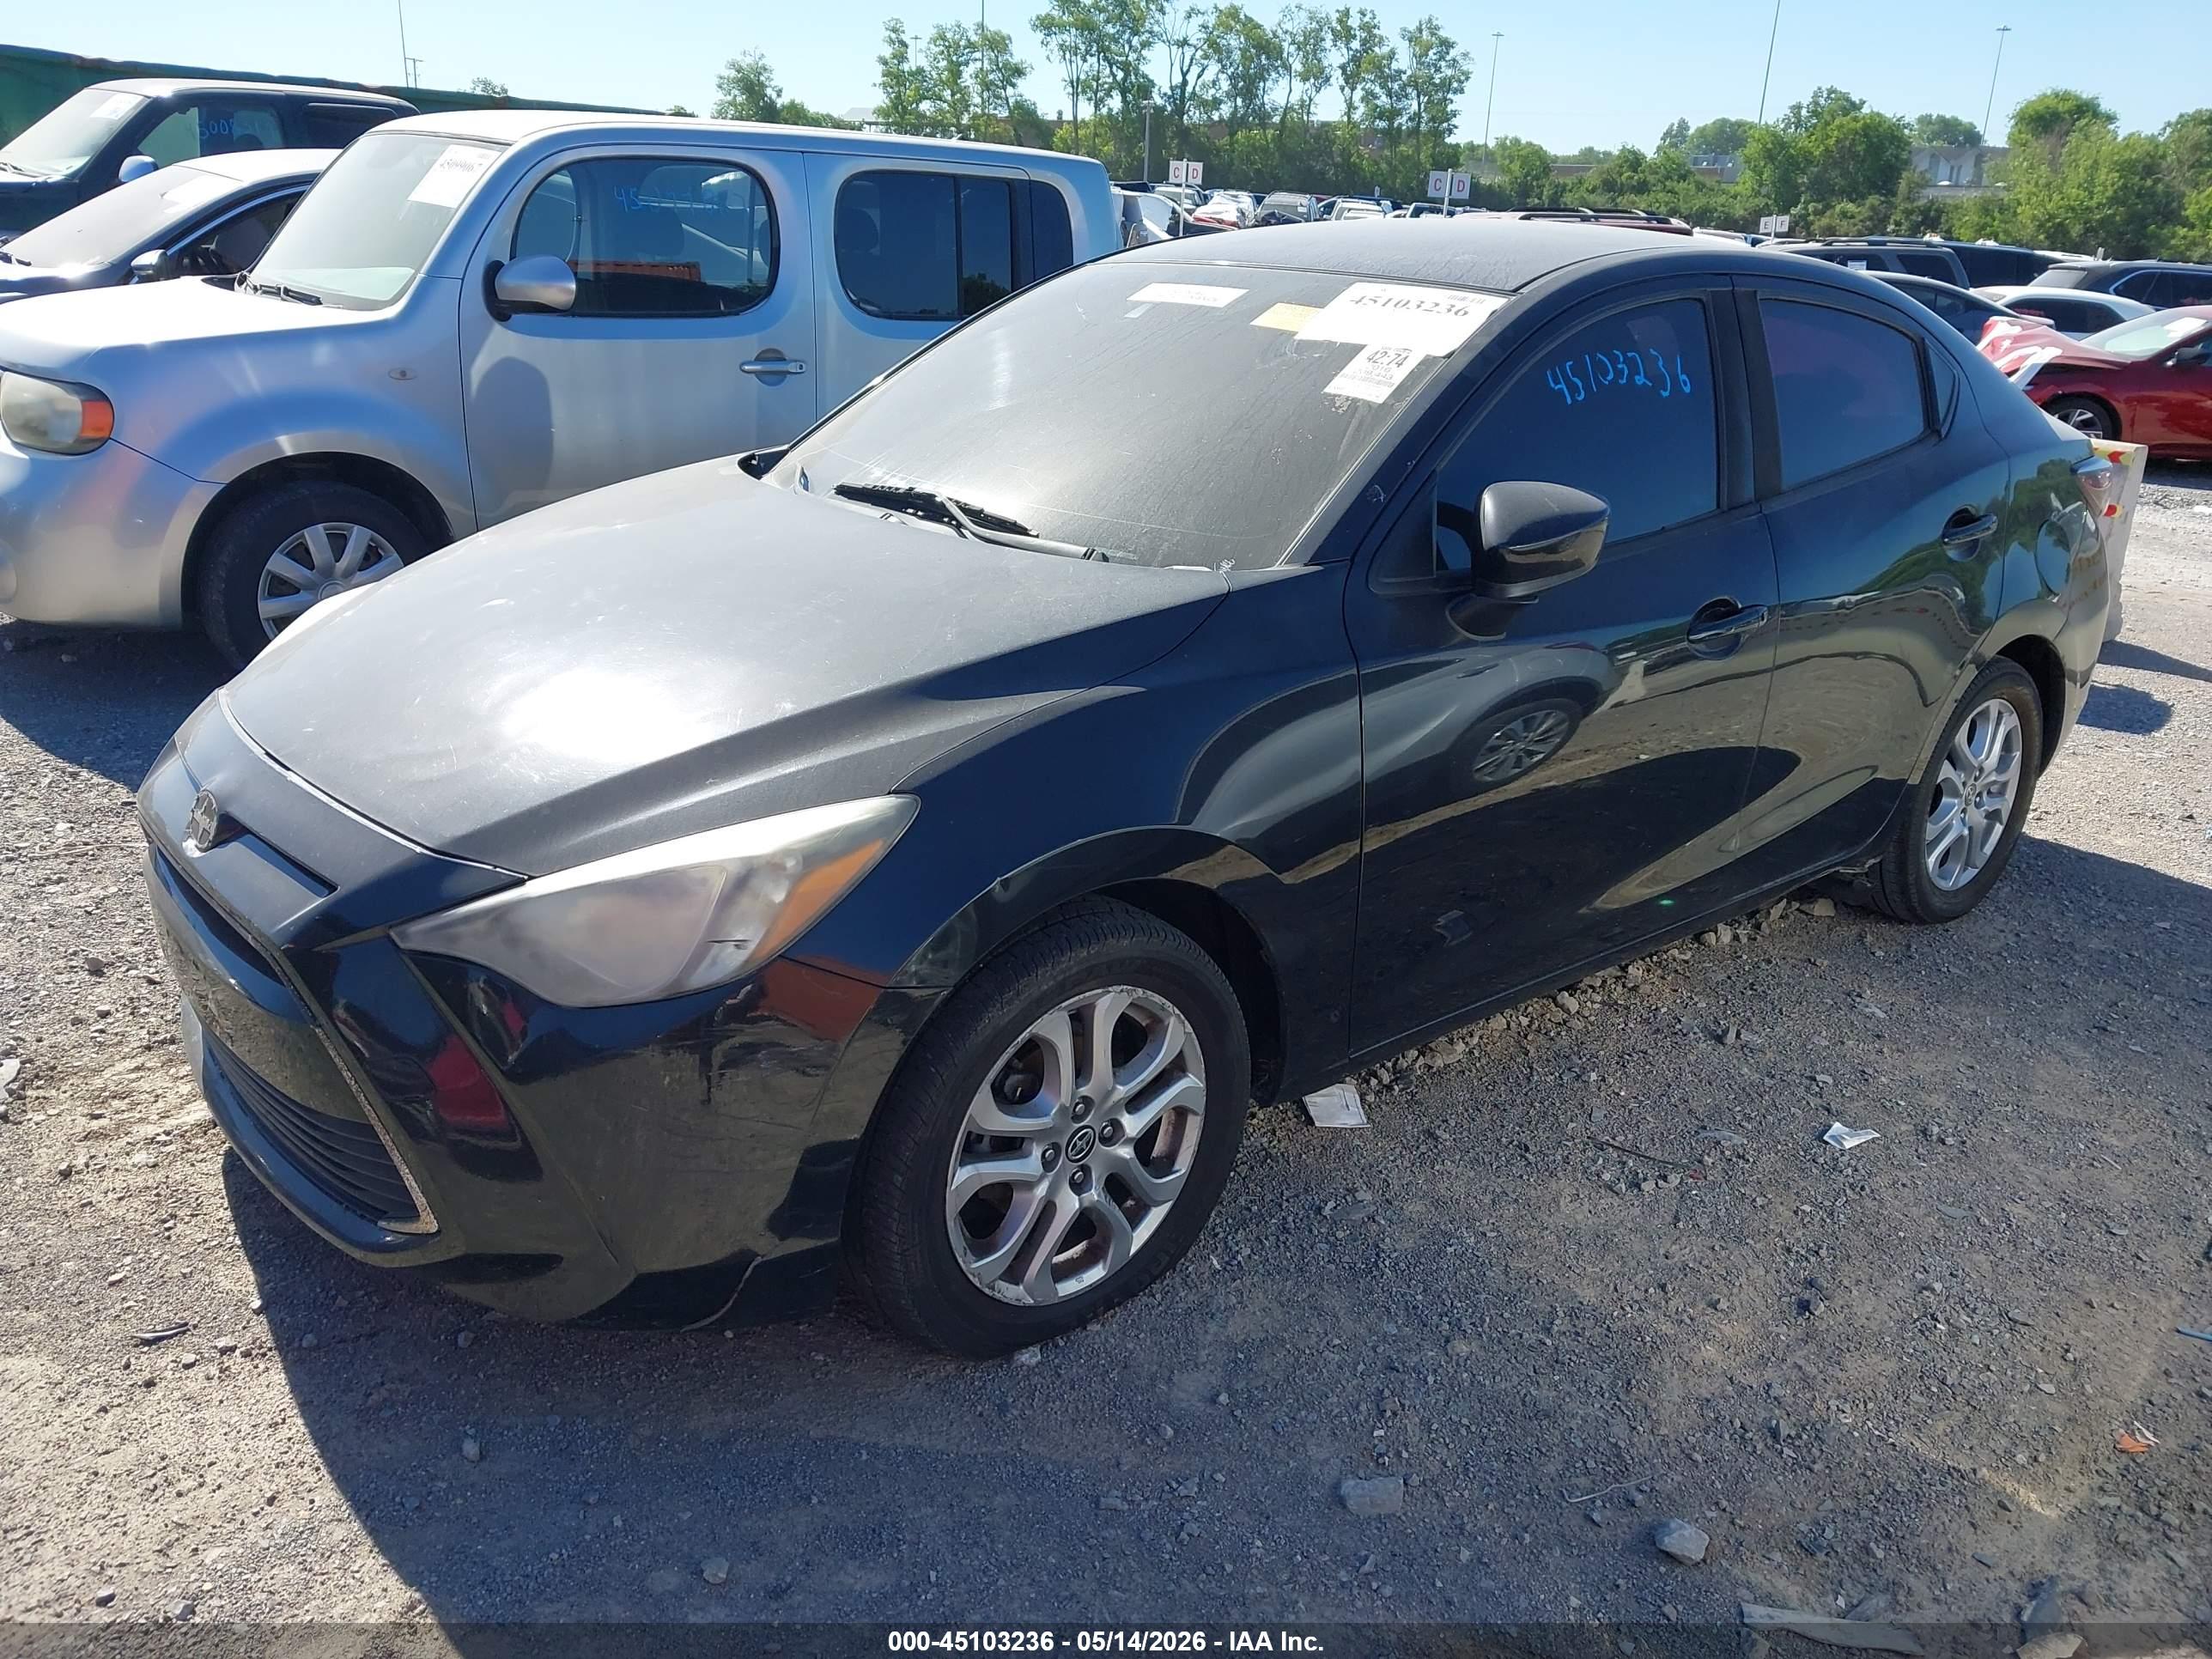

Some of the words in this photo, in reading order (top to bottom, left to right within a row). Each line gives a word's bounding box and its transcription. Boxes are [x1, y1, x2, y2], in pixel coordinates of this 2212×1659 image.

[1173, 167, 1180, 179] C
[1192, 167, 1199, 179] D
[1434, 178, 1442, 191] C
[1457, 179, 1465, 192] D
[1764, 221, 1770, 229] E
[1780, 220, 1786, 228] F
[1350, 295, 1471, 317] 45103236
[1366, 349, 1409, 368] 42:74
[1546, 348, 1692, 405] 45103236
